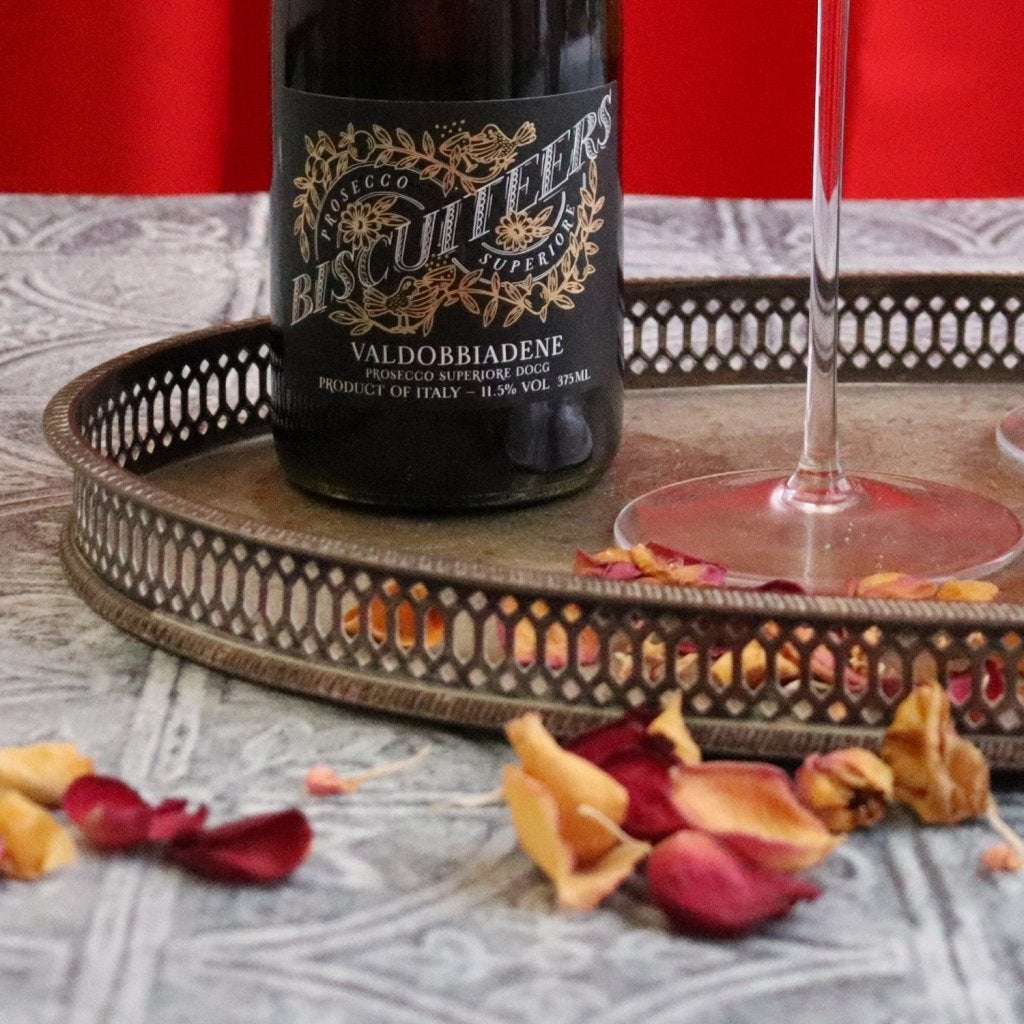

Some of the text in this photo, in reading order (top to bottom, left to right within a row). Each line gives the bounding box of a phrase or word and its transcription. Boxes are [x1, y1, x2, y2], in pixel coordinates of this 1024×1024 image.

[291, 90, 612, 325] BISCUITEERS
[321, 173, 409, 241] PROSECCO
[479, 204, 576, 273] SUPERIORE
[351, 334, 565, 366] VALDOBBIADENE
[366, 362, 550, 382] PROSECCO SUPERIORE DOCG
[319, 376, 383, 396] PRODUCT
[390, 384, 410, 398] OF
[416, 385, 461, 399] ITALY
[481, 383, 517, 398] 11.5%
[521, 379, 550, 393] VOL
[557, 368, 591, 387] 375ML
